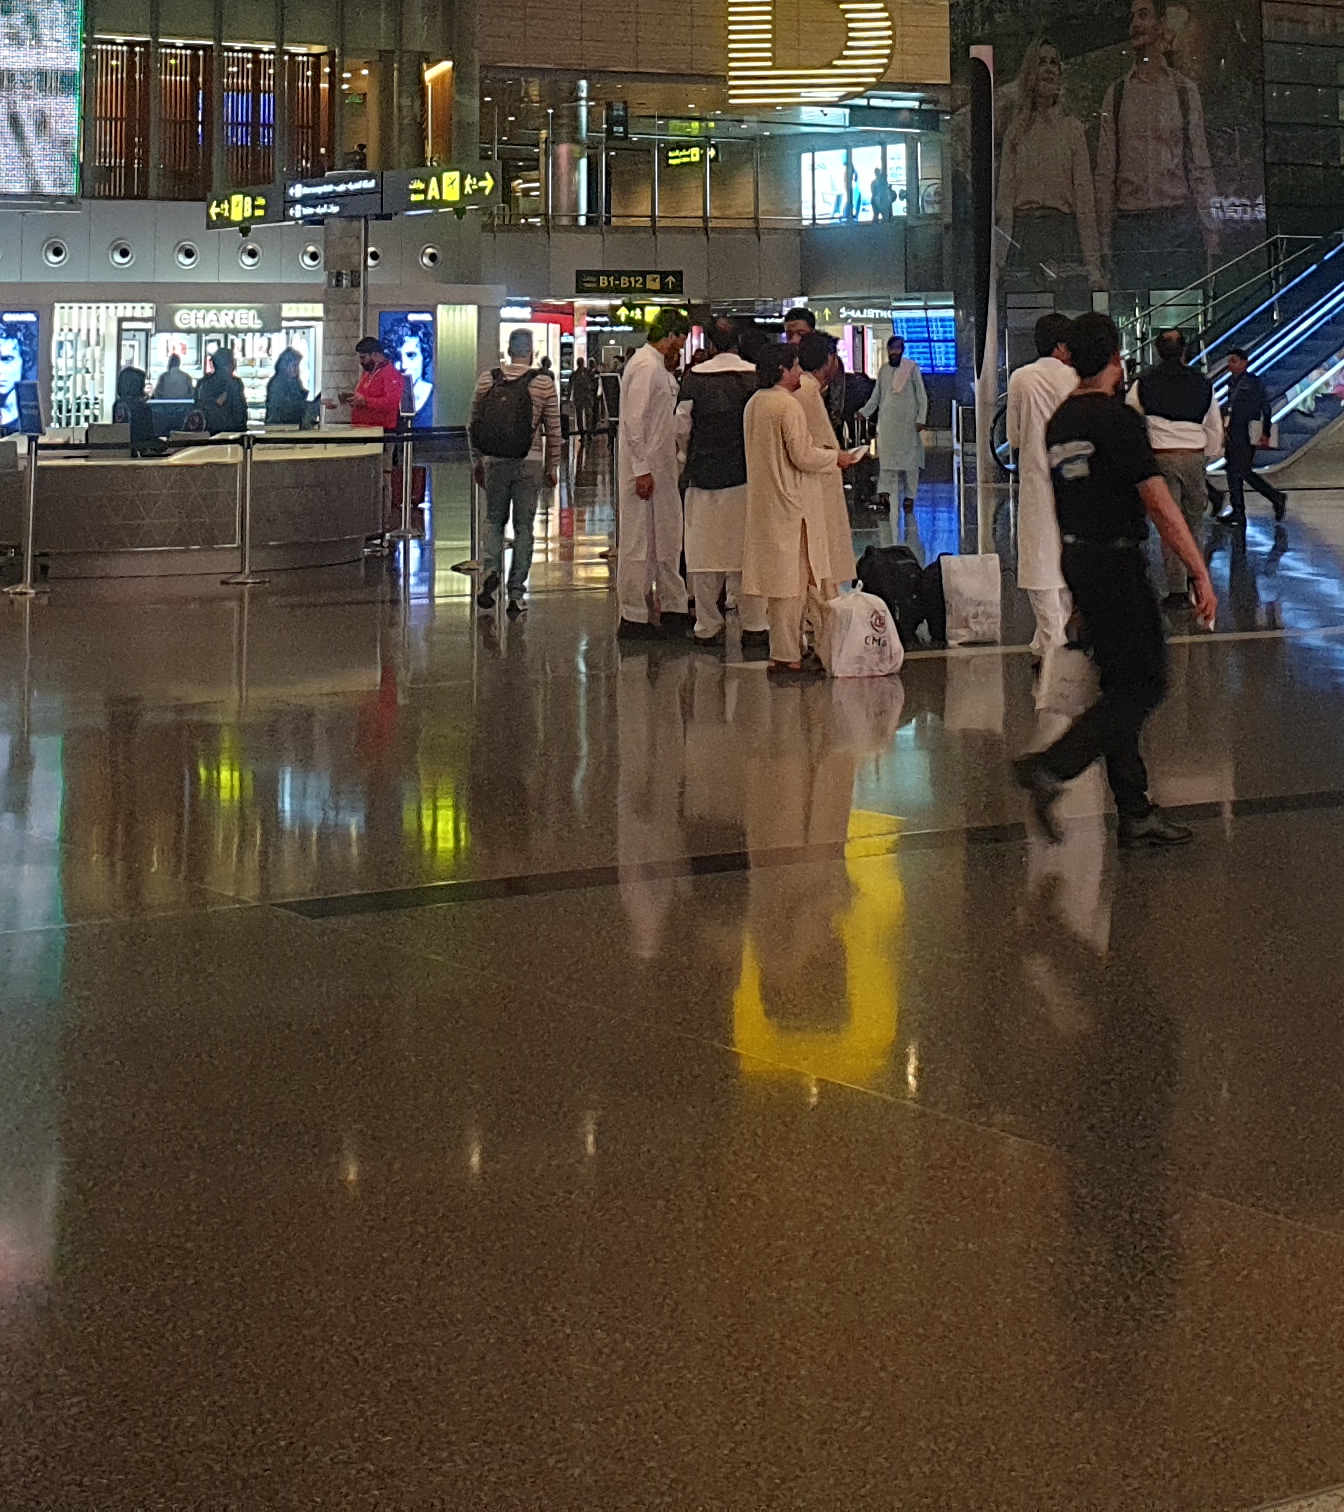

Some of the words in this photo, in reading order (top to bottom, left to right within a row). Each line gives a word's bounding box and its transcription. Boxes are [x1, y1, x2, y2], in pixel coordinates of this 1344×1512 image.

[427, 177, 441, 201] A
[243, 195, 252, 218] B
[599, 274, 644, 289] B1-B12
[175, 309, 263, 329] CHANEL
